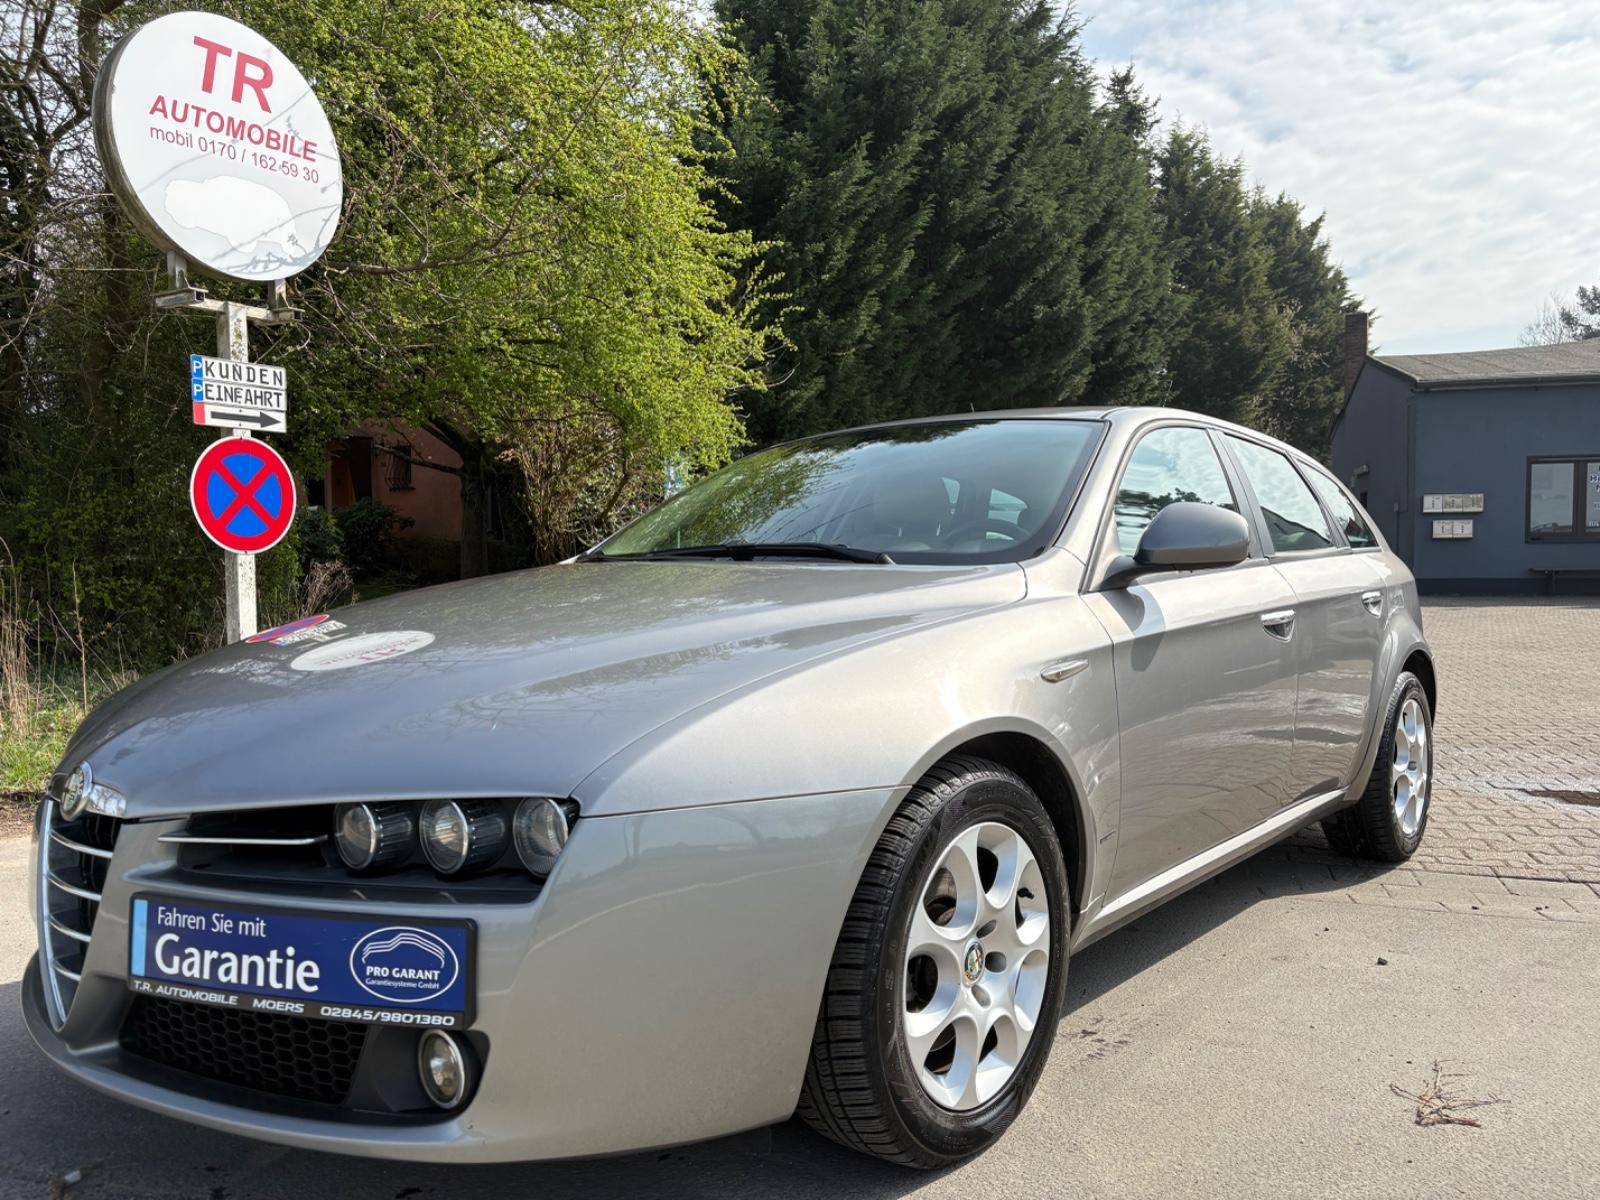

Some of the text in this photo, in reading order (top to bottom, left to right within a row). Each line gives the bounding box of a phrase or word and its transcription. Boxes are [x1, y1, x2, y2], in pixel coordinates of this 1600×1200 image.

[193, 35, 274, 114] TR
[148, 95, 318, 163] AUTOMOBILE
[149, 125, 193, 149] mobil
[198, 136, 237, 161] 0170
[302, 166, 319, 184] 30
[193, 360, 283, 387] P KUNDEN
[194, 383, 283, 408] P EINFAHRT
[157, 906, 267, 938] Fahren Sie mit
[154, 932, 321, 993] Garantie
[366, 966, 441, 980] PRO GARANT
[132, 980, 455, 1026] T.R. AUTOMOBILE MOERS 02845/9801380
[366, 978, 440, 990] Garantiesysteme GmbH
